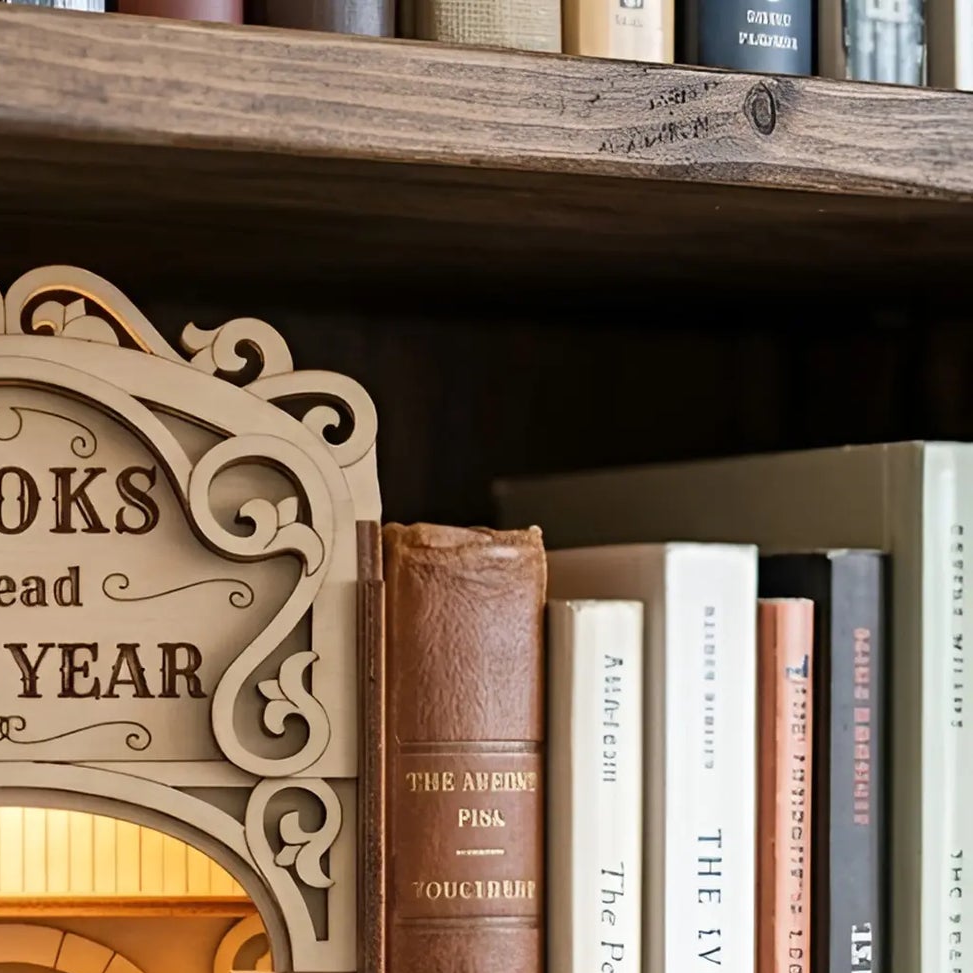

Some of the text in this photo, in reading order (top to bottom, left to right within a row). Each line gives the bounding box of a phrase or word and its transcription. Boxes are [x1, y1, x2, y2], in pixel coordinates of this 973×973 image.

[3, 641, 208, 700] YEAR
[406, 771, 455, 792] THE
[600, 861, 625, 927] The
[698, 829, 722, 904] THE
